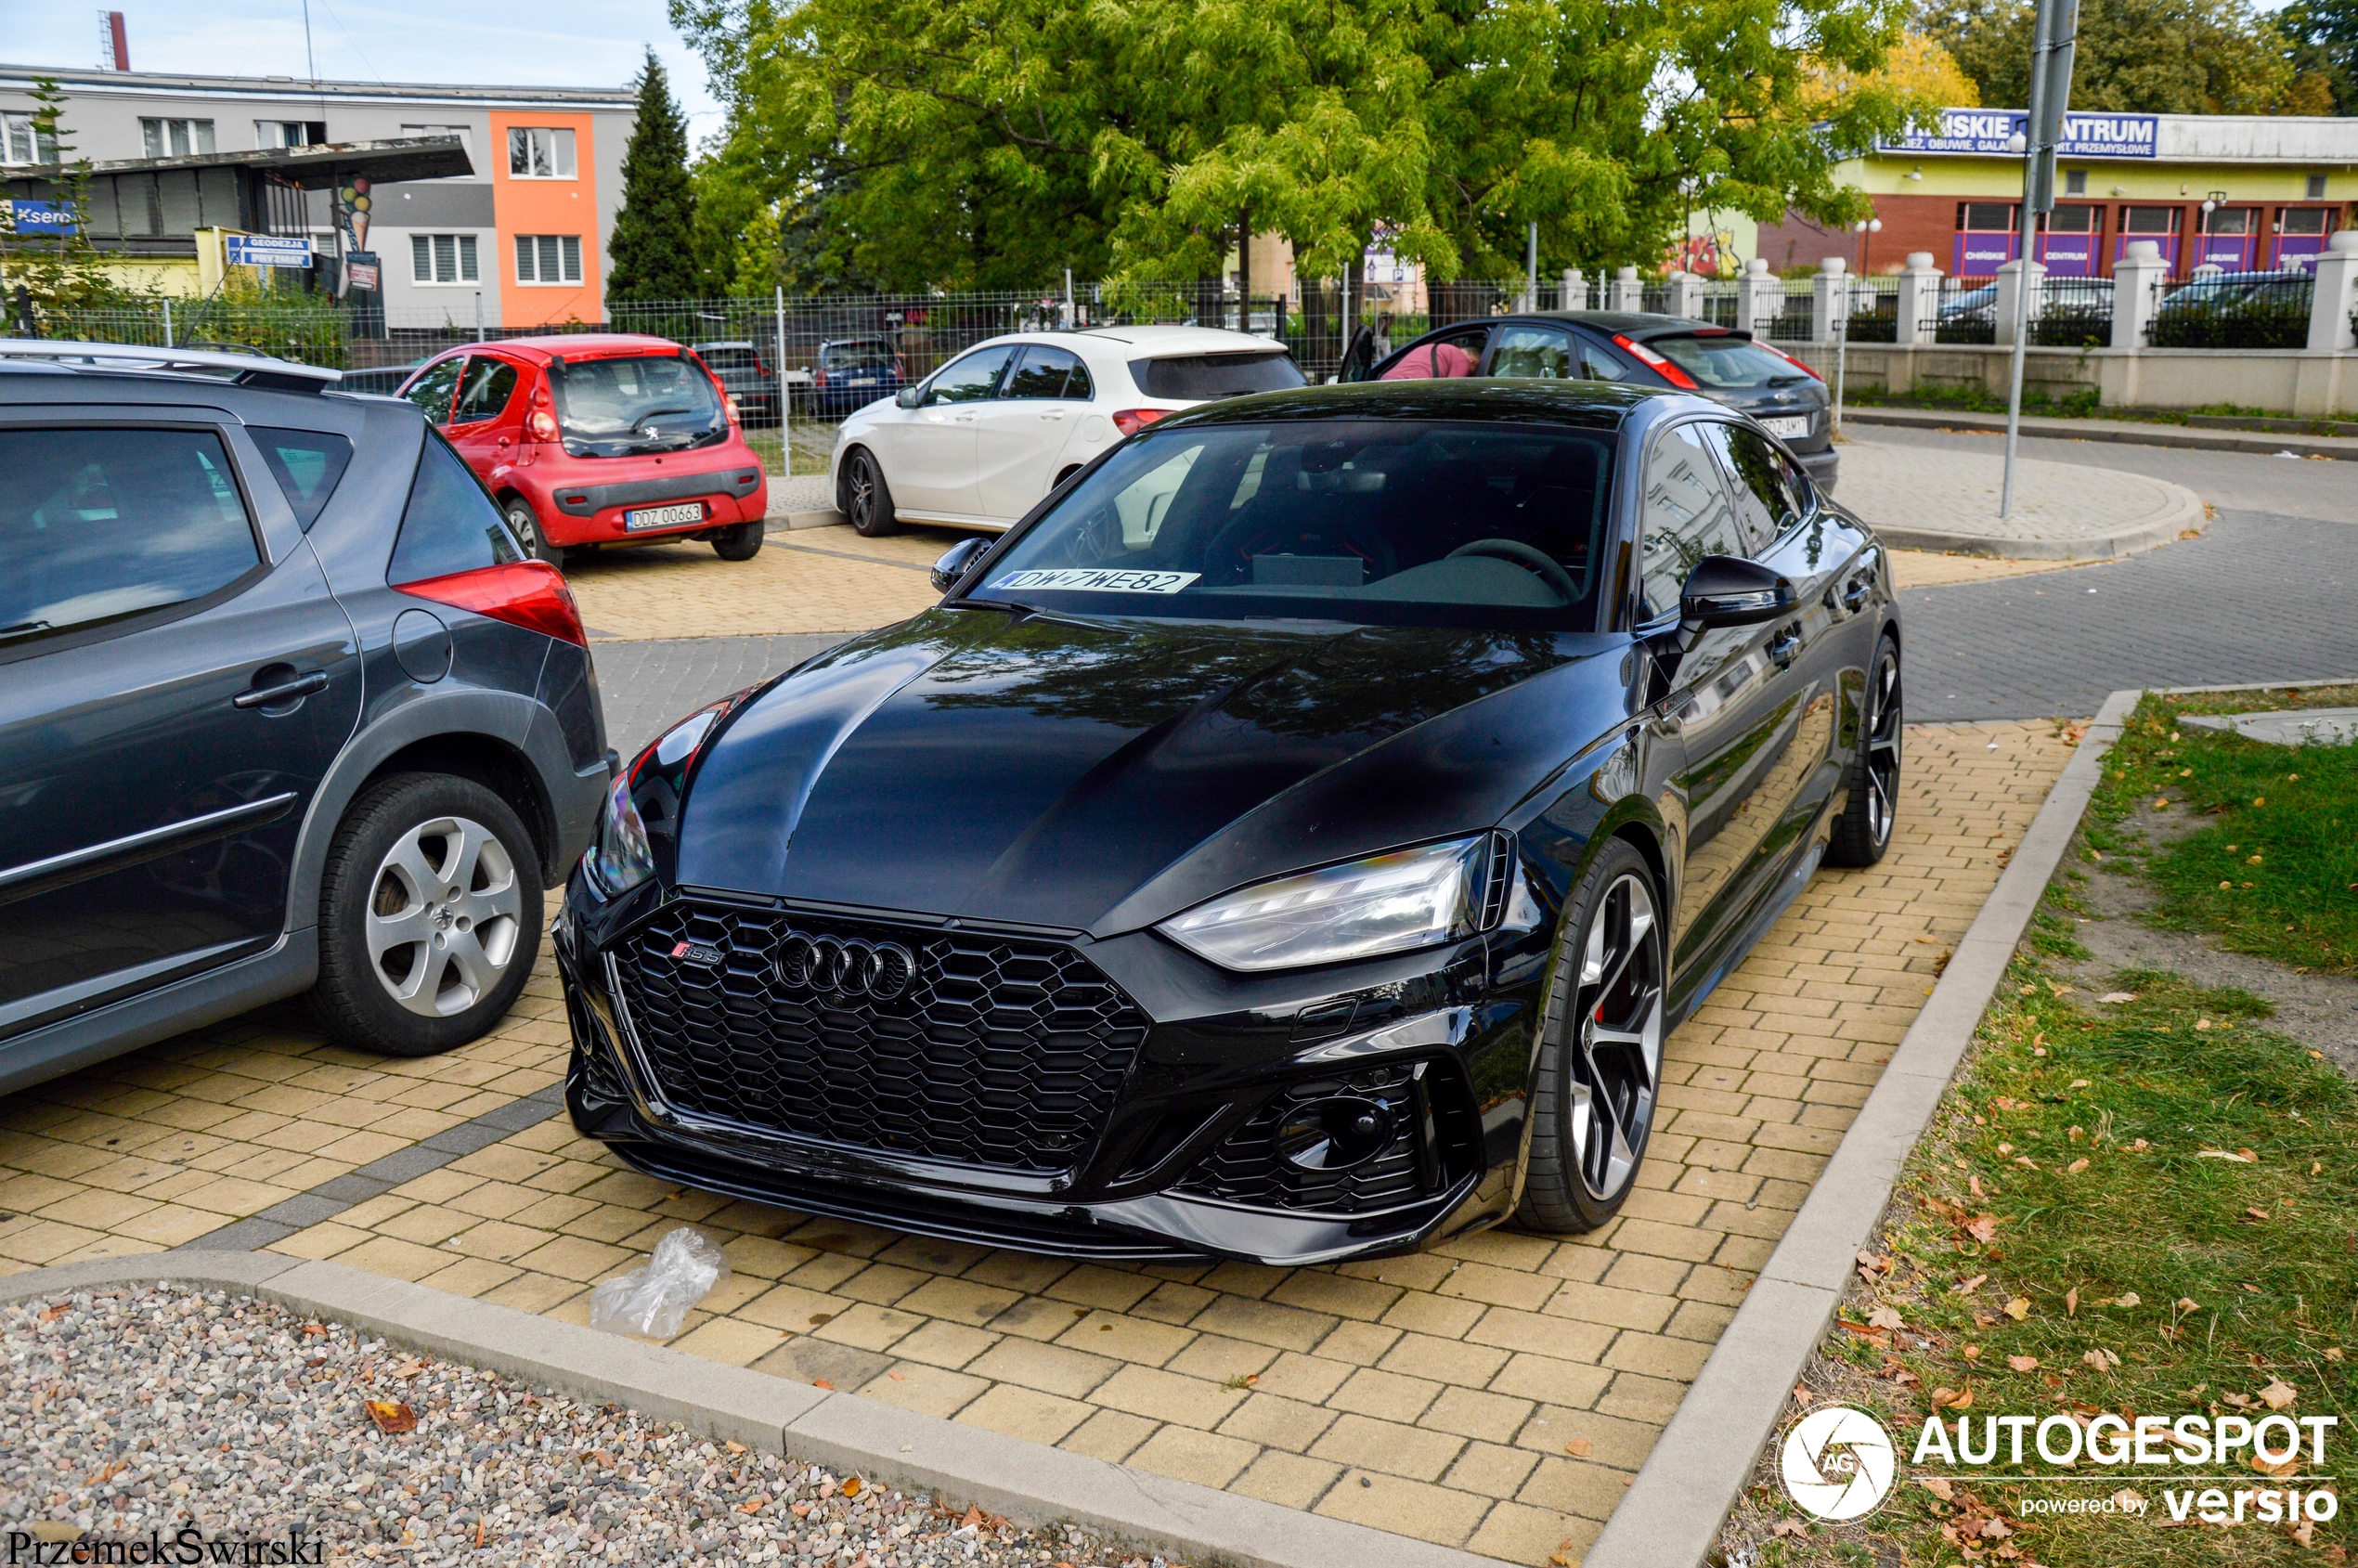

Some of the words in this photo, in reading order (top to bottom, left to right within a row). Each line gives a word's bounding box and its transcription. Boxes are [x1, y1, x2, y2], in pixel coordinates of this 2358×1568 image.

[2063, 118, 2154, 142] NTRUM
[1928, 138, 1976, 151] OBUWIE,
[2076, 144, 2152, 155] PRZEMYSŁOWE
[251, 239, 304, 249] GEODEZJA
[2044, 252, 2088, 261] CENTRUM
[2206, 253, 2239, 262] OBUWIE
[634, 511, 658, 527] DDZ
[662, 505, 700, 524] 00663
[1063, 571, 1181, 592] 7WE82
